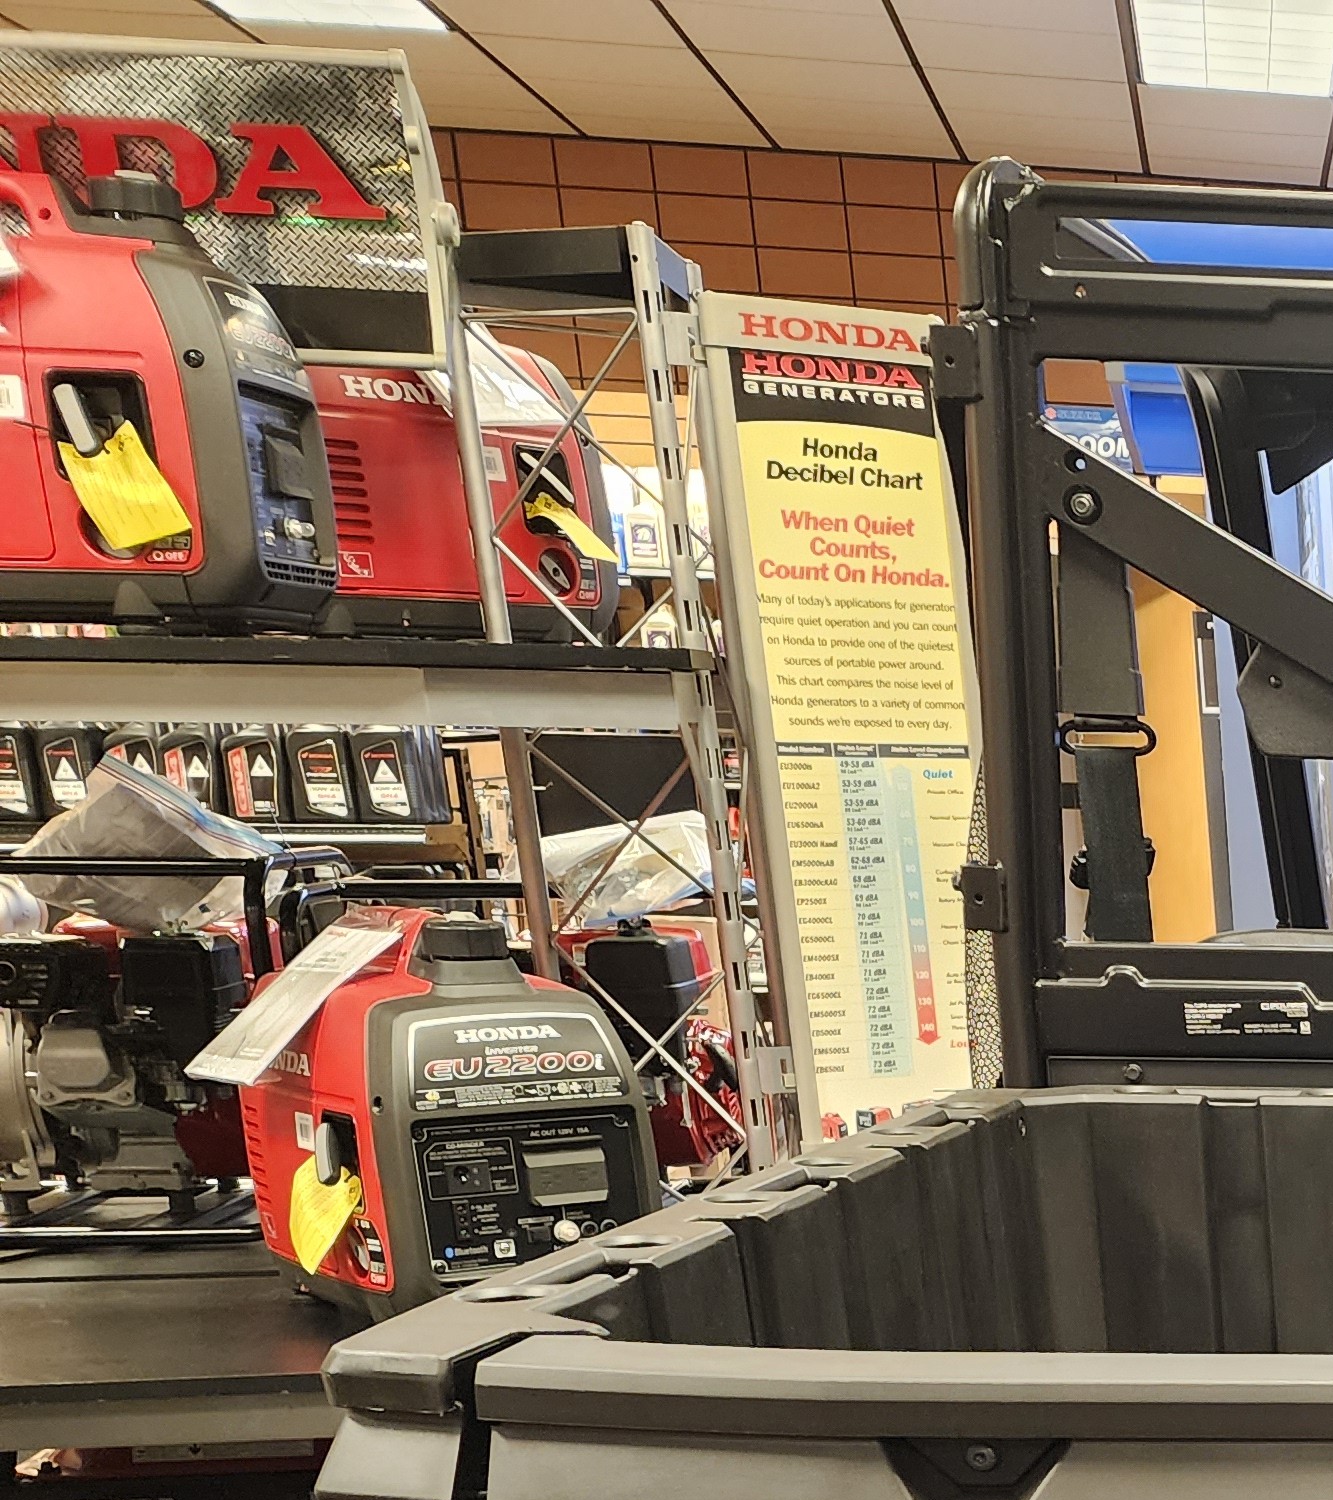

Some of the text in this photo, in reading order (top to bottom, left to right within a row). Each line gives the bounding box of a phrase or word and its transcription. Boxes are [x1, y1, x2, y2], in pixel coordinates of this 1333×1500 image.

[738, 312, 920, 353] HONDA
[741, 350, 922, 390] HONDA
[743, 380, 926, 410] GENERATORS
[802, 437, 878, 462] Honda
[766, 460, 923, 491] Decibel Chart
[781, 509, 915, 538] When Quiet
[809, 536, 897, 565] Counts,
[758, 558, 950, 588] Count On Honda.
[786, 594, 795, 605] of
[798, 595, 831, 608] today's
[834, 597, 892, 610] applications
[894, 599, 907, 610] for
[760, 616, 958, 633] require quiet operation and you can count
[767, 635, 954, 653] on Honda to provide one of the quietest
[784, 656, 944, 671] sources of portable power around.
[776, 674, 954, 690] This chart compares the noise level of
[771, 695, 803, 706] Honda
[807, 696, 857, 709] generators
[860, 698, 869, 707] to
[881, 698, 910, 710] variety
[913, 698, 922, 708] of
[924, 701, 965, 710] common
[789, 715, 952, 731] sounds we're exposed to every day.
[923, 769, 953, 780] Quiet
[454, 1024, 562, 1044] HONDA
[266, 1050, 311, 1077] NDA
[424, 1050, 606, 1082] EU2200i
